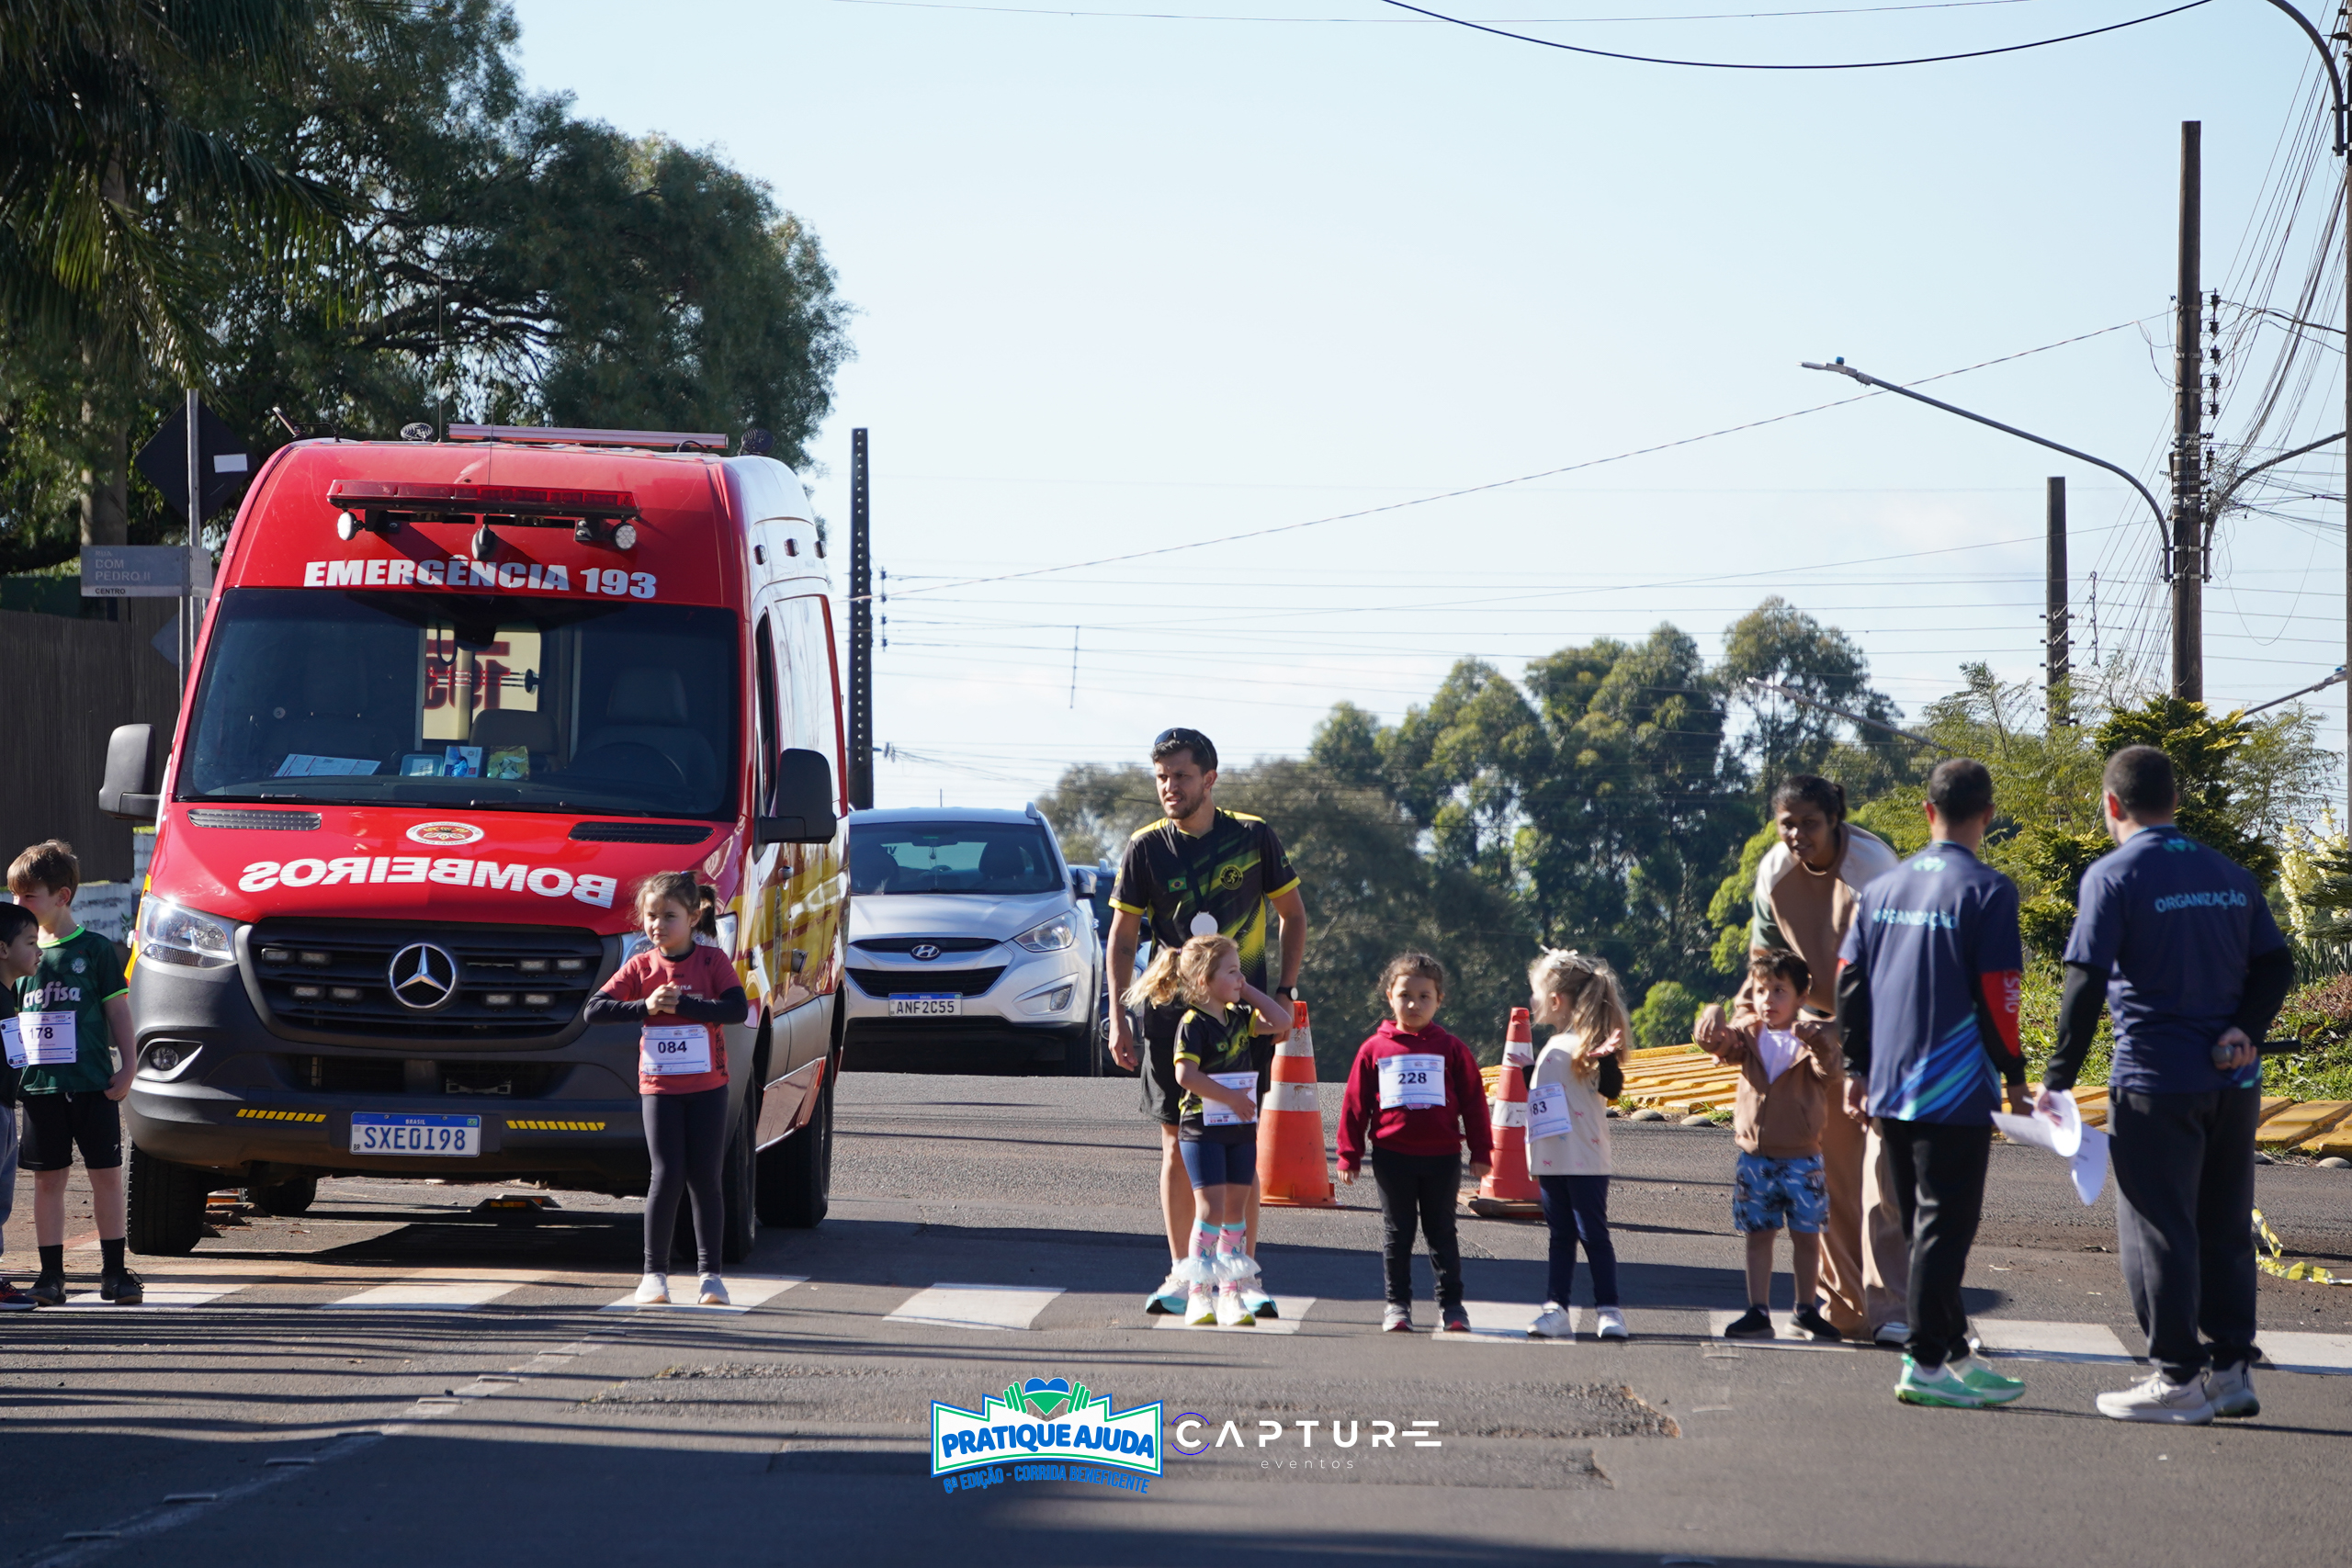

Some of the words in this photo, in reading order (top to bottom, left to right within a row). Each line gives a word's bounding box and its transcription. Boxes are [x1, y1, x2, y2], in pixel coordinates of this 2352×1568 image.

[95, 558, 125, 570] DOM
[95, 570, 141, 581] PEDRO
[143, 570, 151, 581] II
[303, 554, 570, 591] EMERGÊNCIA
[580, 567, 656, 599] 193
[95, 587, 127, 595] CENTRO
[2154, 889, 2248, 913] ORGANIZAÇÃO
[23, 981, 81, 1009] crefisa
[897, 1000, 955, 1014] ANF2C55
[28, 1026, 53, 1039] 178
[658, 1041, 687, 1054] 084
[1397, 1072, 1427, 1085] 228
